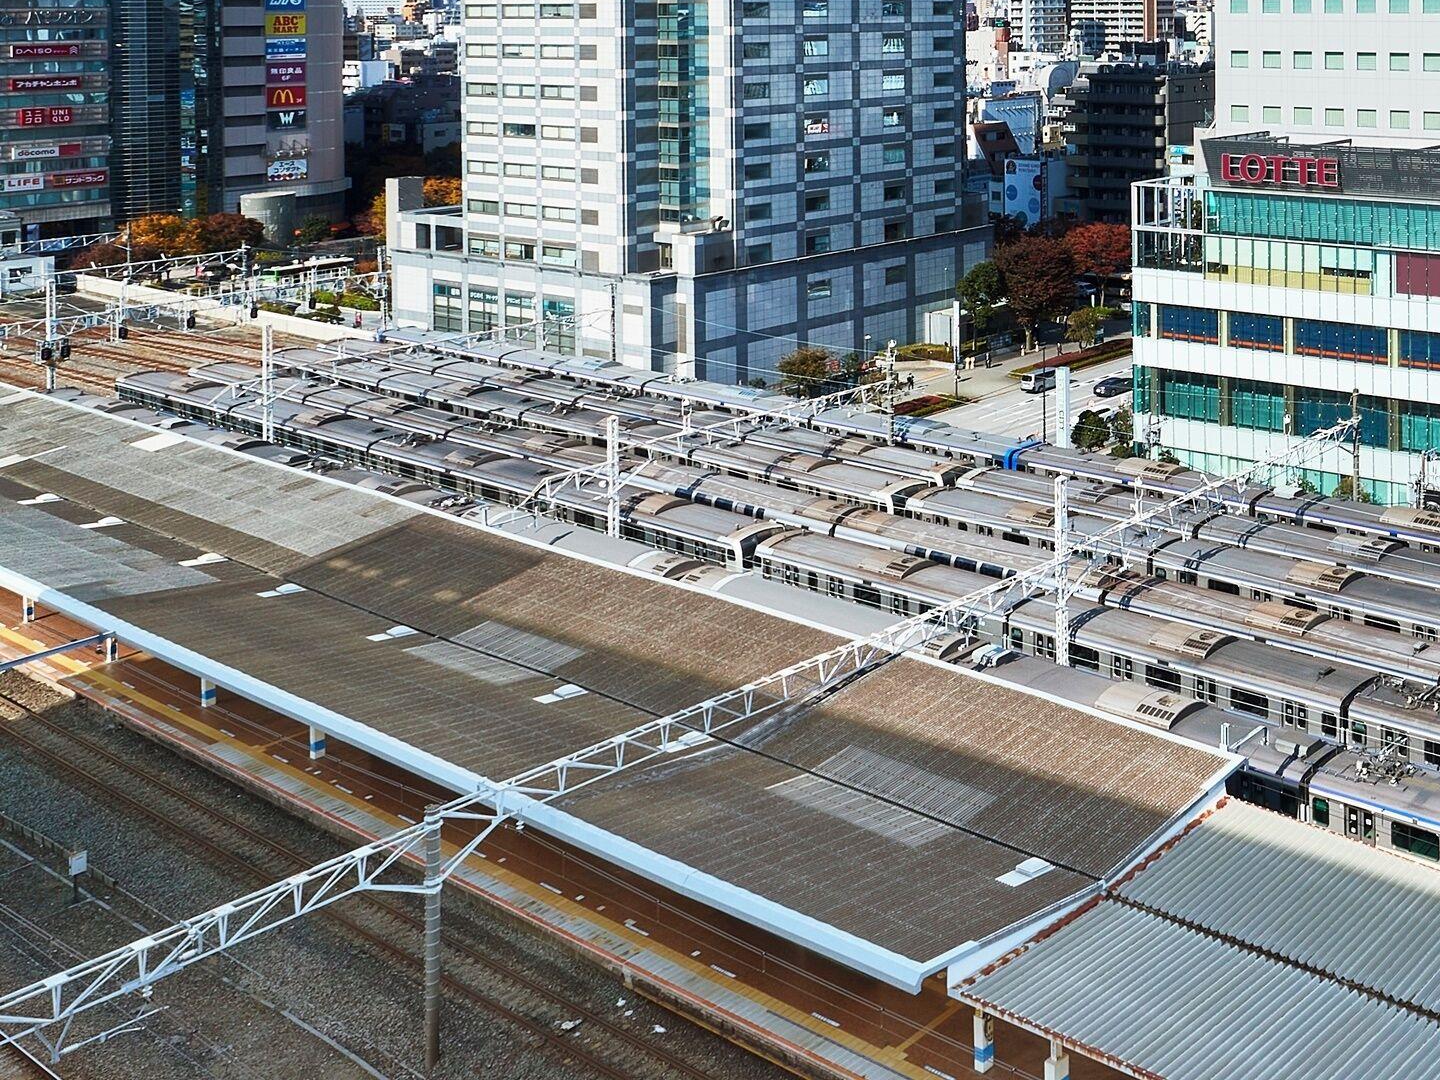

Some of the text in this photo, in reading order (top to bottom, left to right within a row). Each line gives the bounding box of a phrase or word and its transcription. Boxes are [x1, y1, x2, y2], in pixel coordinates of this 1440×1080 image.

[273, 15, 299, 26] ABC
[272, 26, 299, 34] MART
[15, 47, 53, 55] DAISO
[17, 148, 56, 157] docomo
[1221, 153, 1338, 187] LOTTE
[7, 177, 41, 188] LIFE
